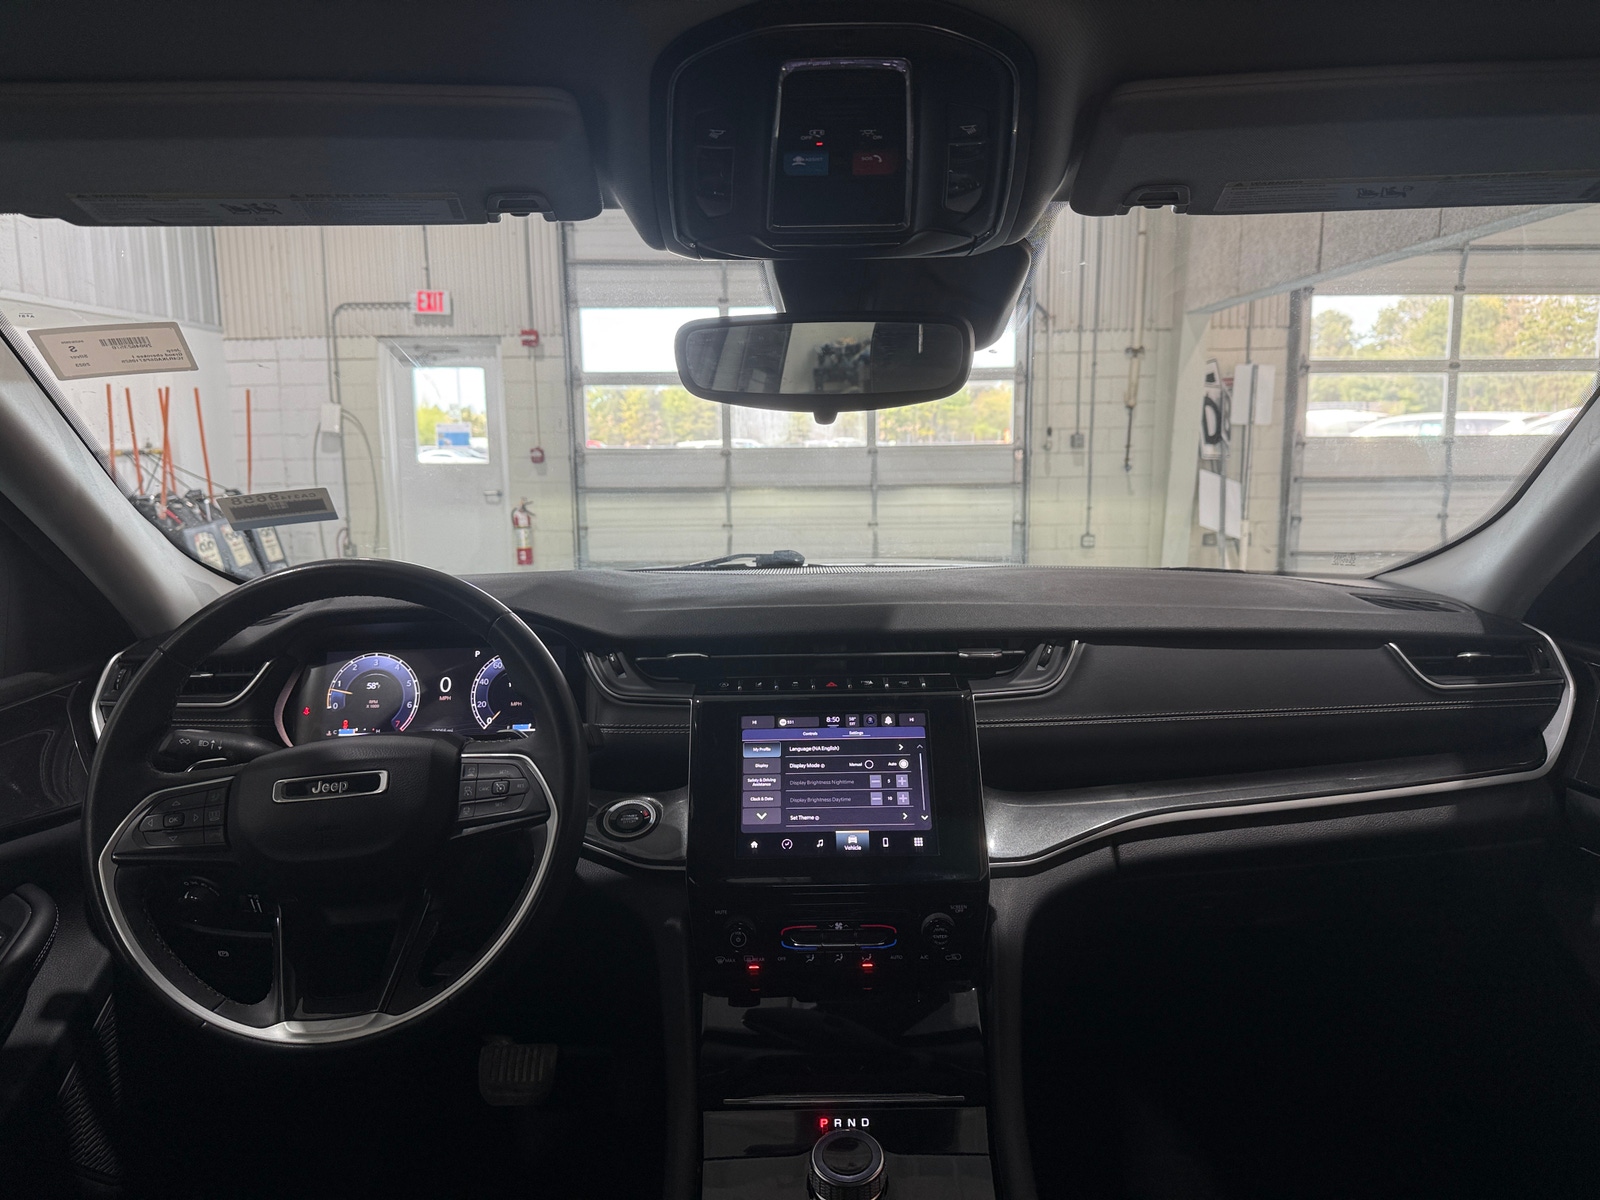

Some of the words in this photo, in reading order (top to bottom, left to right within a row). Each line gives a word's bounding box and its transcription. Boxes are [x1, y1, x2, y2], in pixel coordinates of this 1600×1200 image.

[417, 290, 444, 312] EXIT
[439, 676, 452, 693] 0
[311, 780, 349, 794] Jeep
[820, 1118, 828, 1128] P
[834, 1118, 842, 1127] R
[848, 1118, 856, 1127] N
[861, 1118, 869, 1127] D
